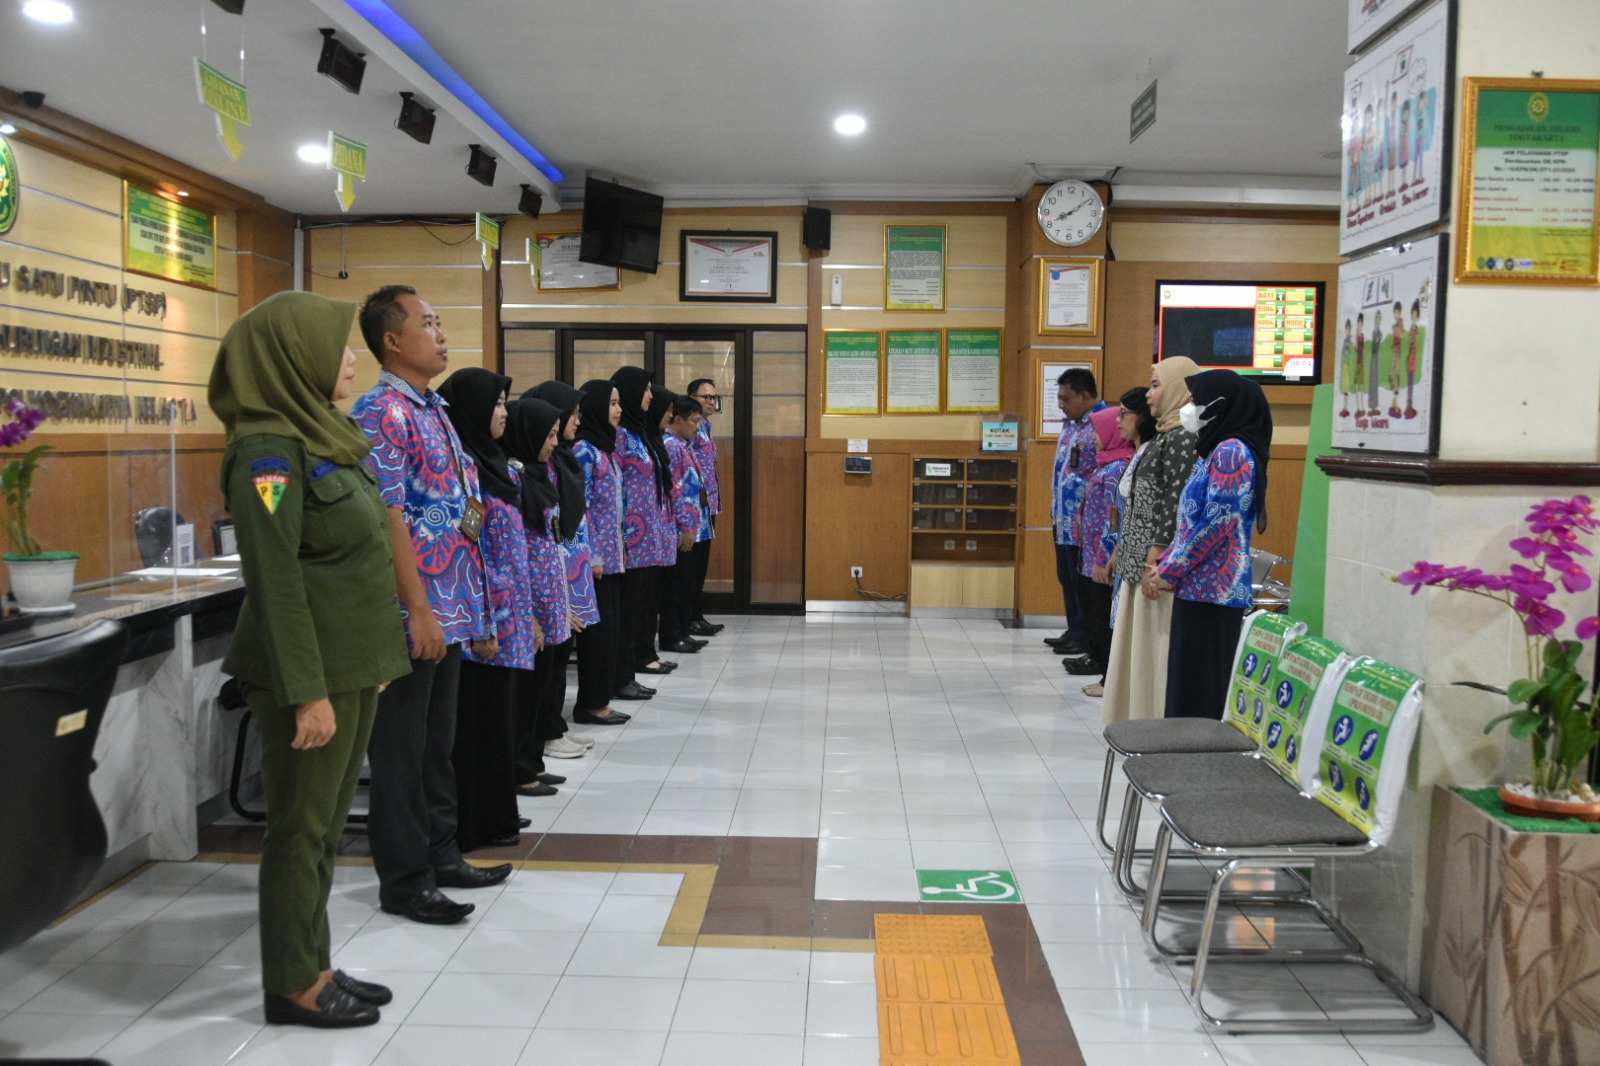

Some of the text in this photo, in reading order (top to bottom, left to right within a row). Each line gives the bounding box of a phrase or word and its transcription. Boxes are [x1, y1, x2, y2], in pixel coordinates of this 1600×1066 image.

[14, 264, 64, 299] SATU
[67, 275, 117, 309] PINTU
[260, 485, 280, 496] P S
